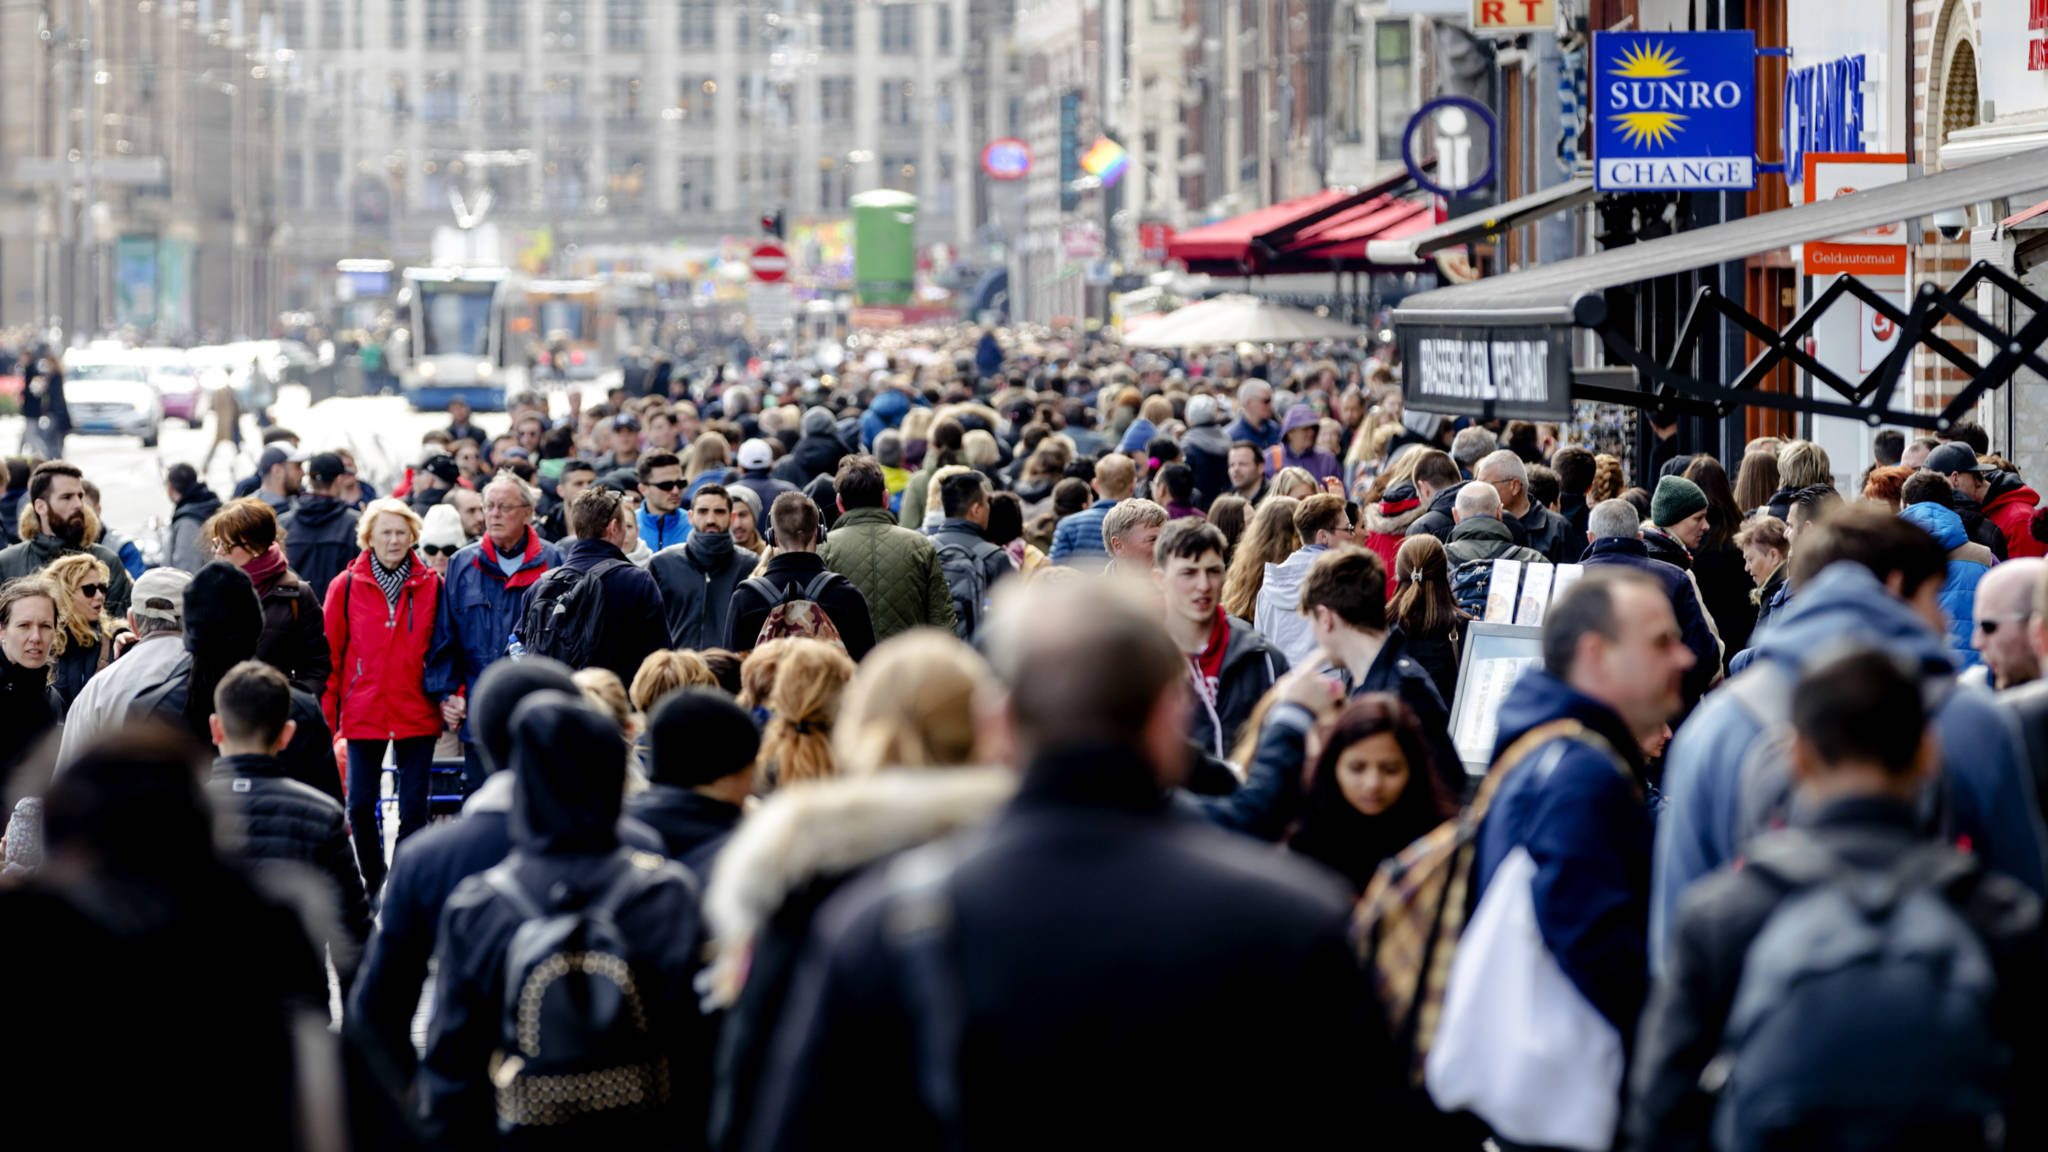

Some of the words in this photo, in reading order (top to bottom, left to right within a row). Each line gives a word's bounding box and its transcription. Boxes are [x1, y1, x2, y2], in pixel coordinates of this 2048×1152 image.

[1610, 80, 1742, 109] SUNRO
[1783, 54, 1866, 187] CHANGE
[1611, 161, 1742, 185] CHANGE
[1812, 251, 1896, 265] Geldautomaat
